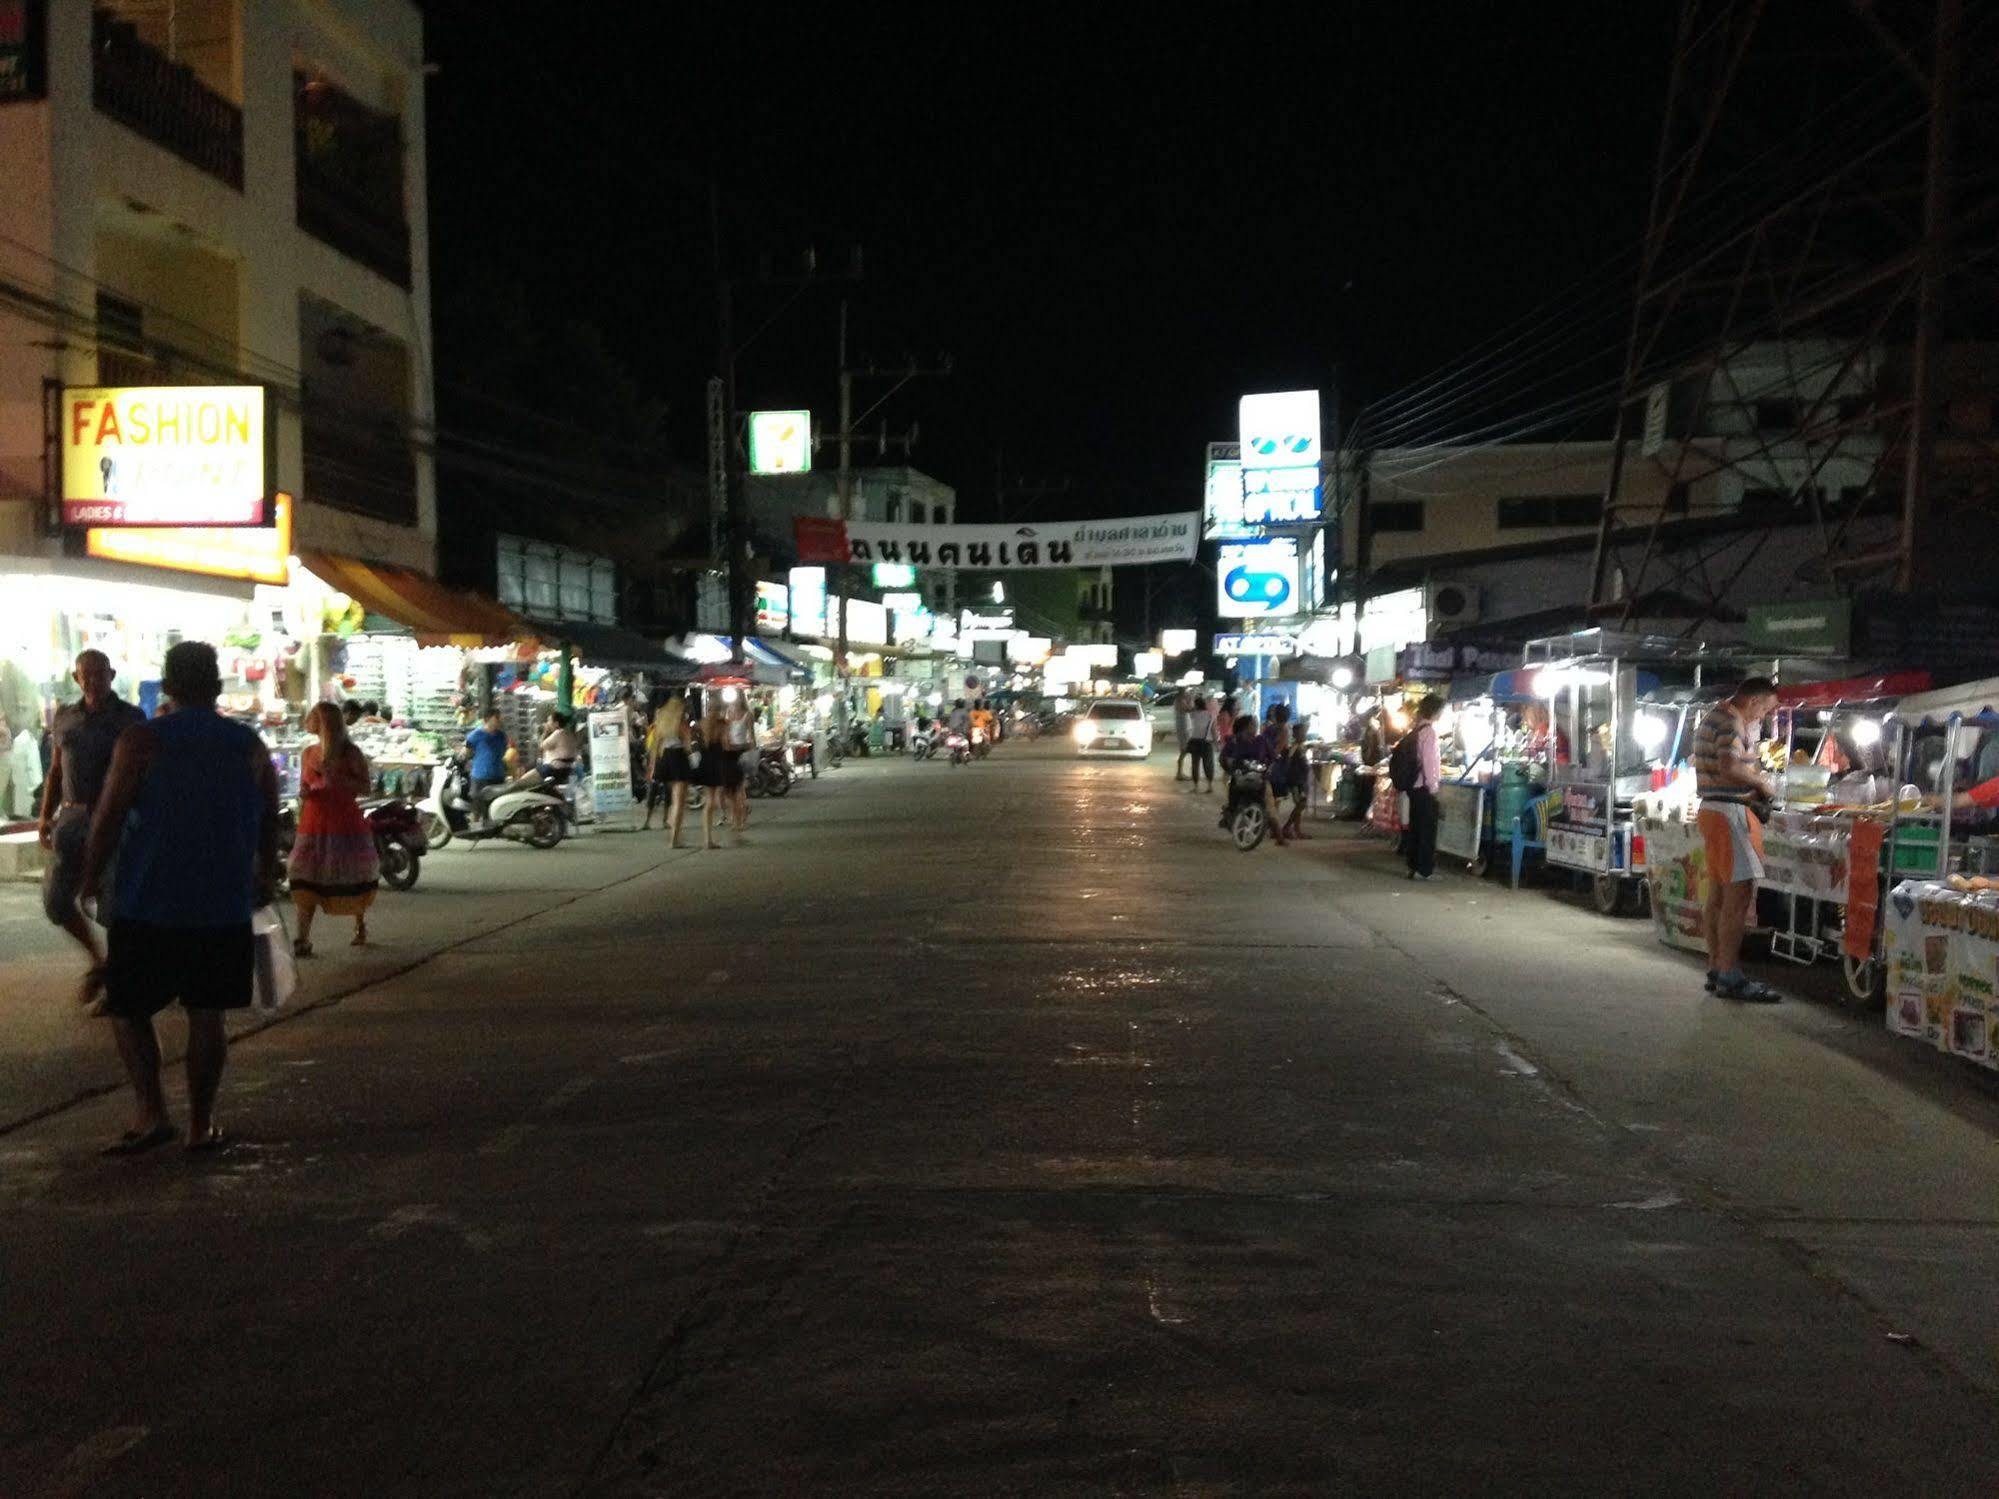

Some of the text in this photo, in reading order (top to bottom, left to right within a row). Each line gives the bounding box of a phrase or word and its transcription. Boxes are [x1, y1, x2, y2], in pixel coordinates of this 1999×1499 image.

[70, 399, 250, 446] FASHION
[851, 527, 1073, 565] ถนนคนเดิน
